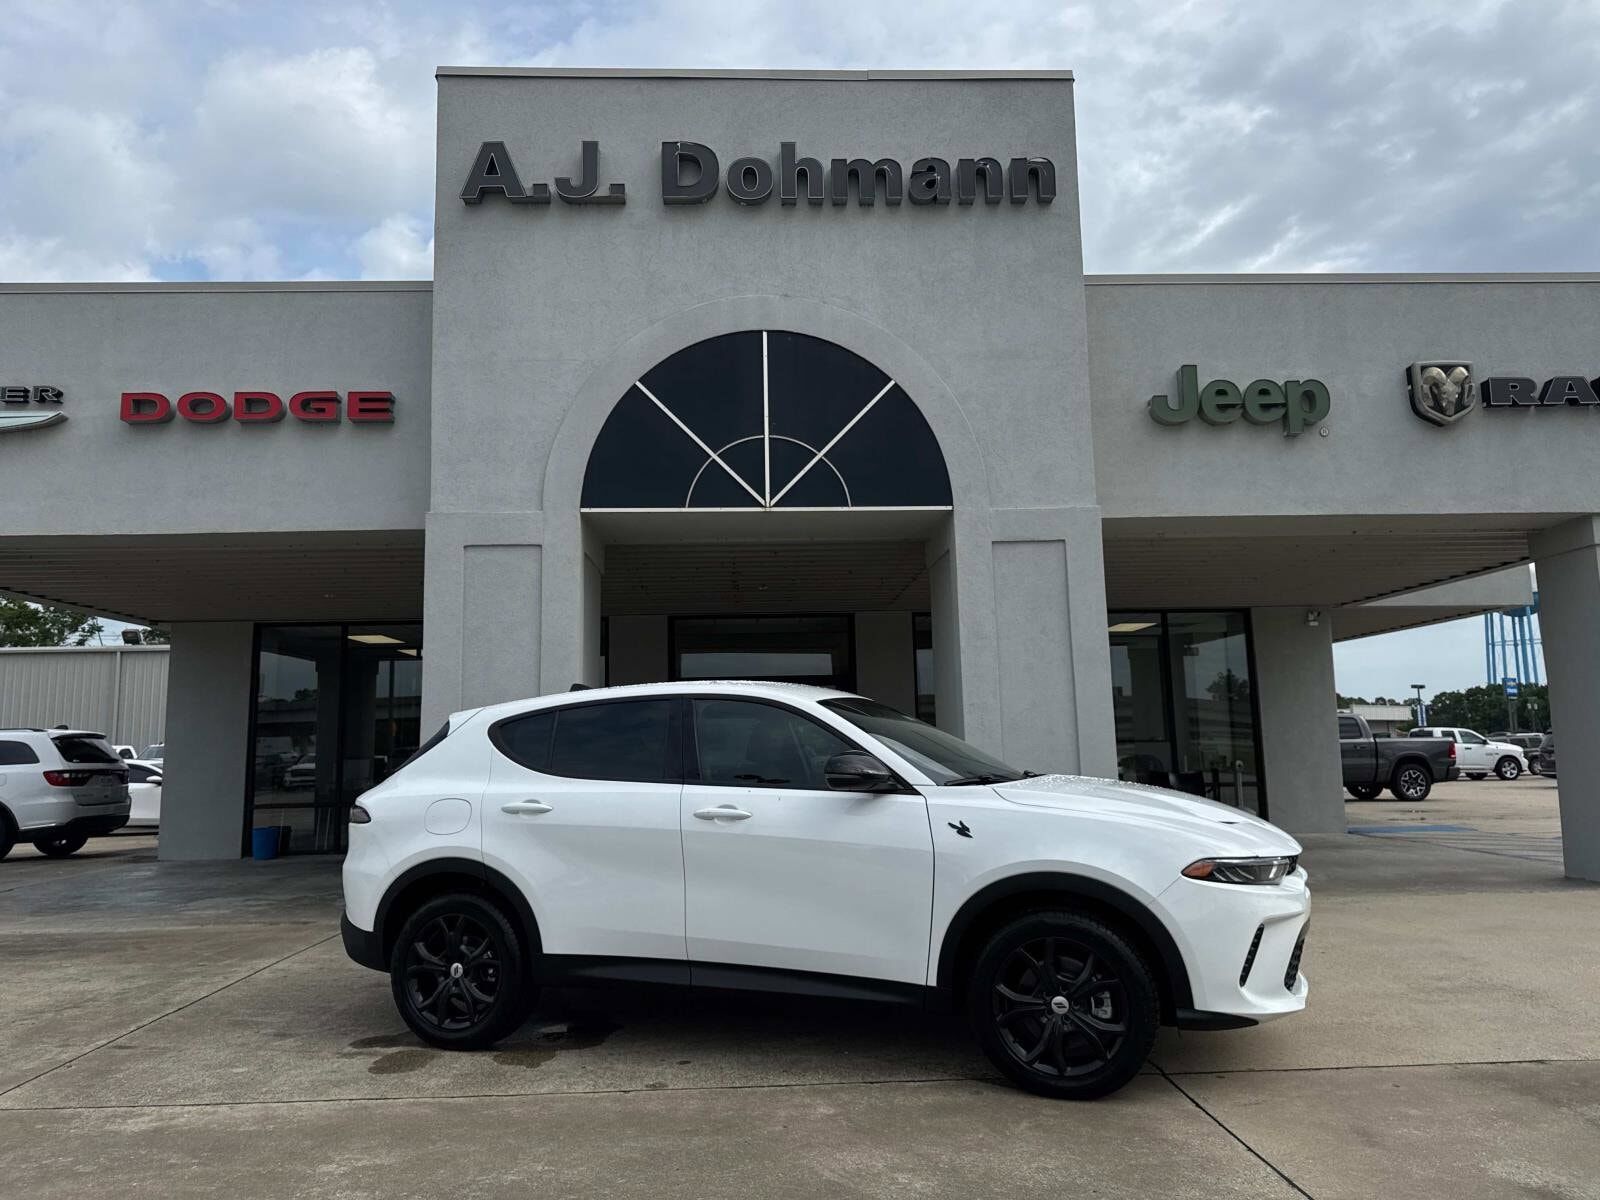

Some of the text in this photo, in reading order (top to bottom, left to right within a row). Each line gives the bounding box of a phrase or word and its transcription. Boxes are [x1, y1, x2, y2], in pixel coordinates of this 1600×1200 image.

[459, 140, 1057, 206] A.J. Dohmann
[119, 391, 395, 425] DODGE
[1150, 364, 1331, 437] Jeep
[1480, 376, 1600, 407] RA
